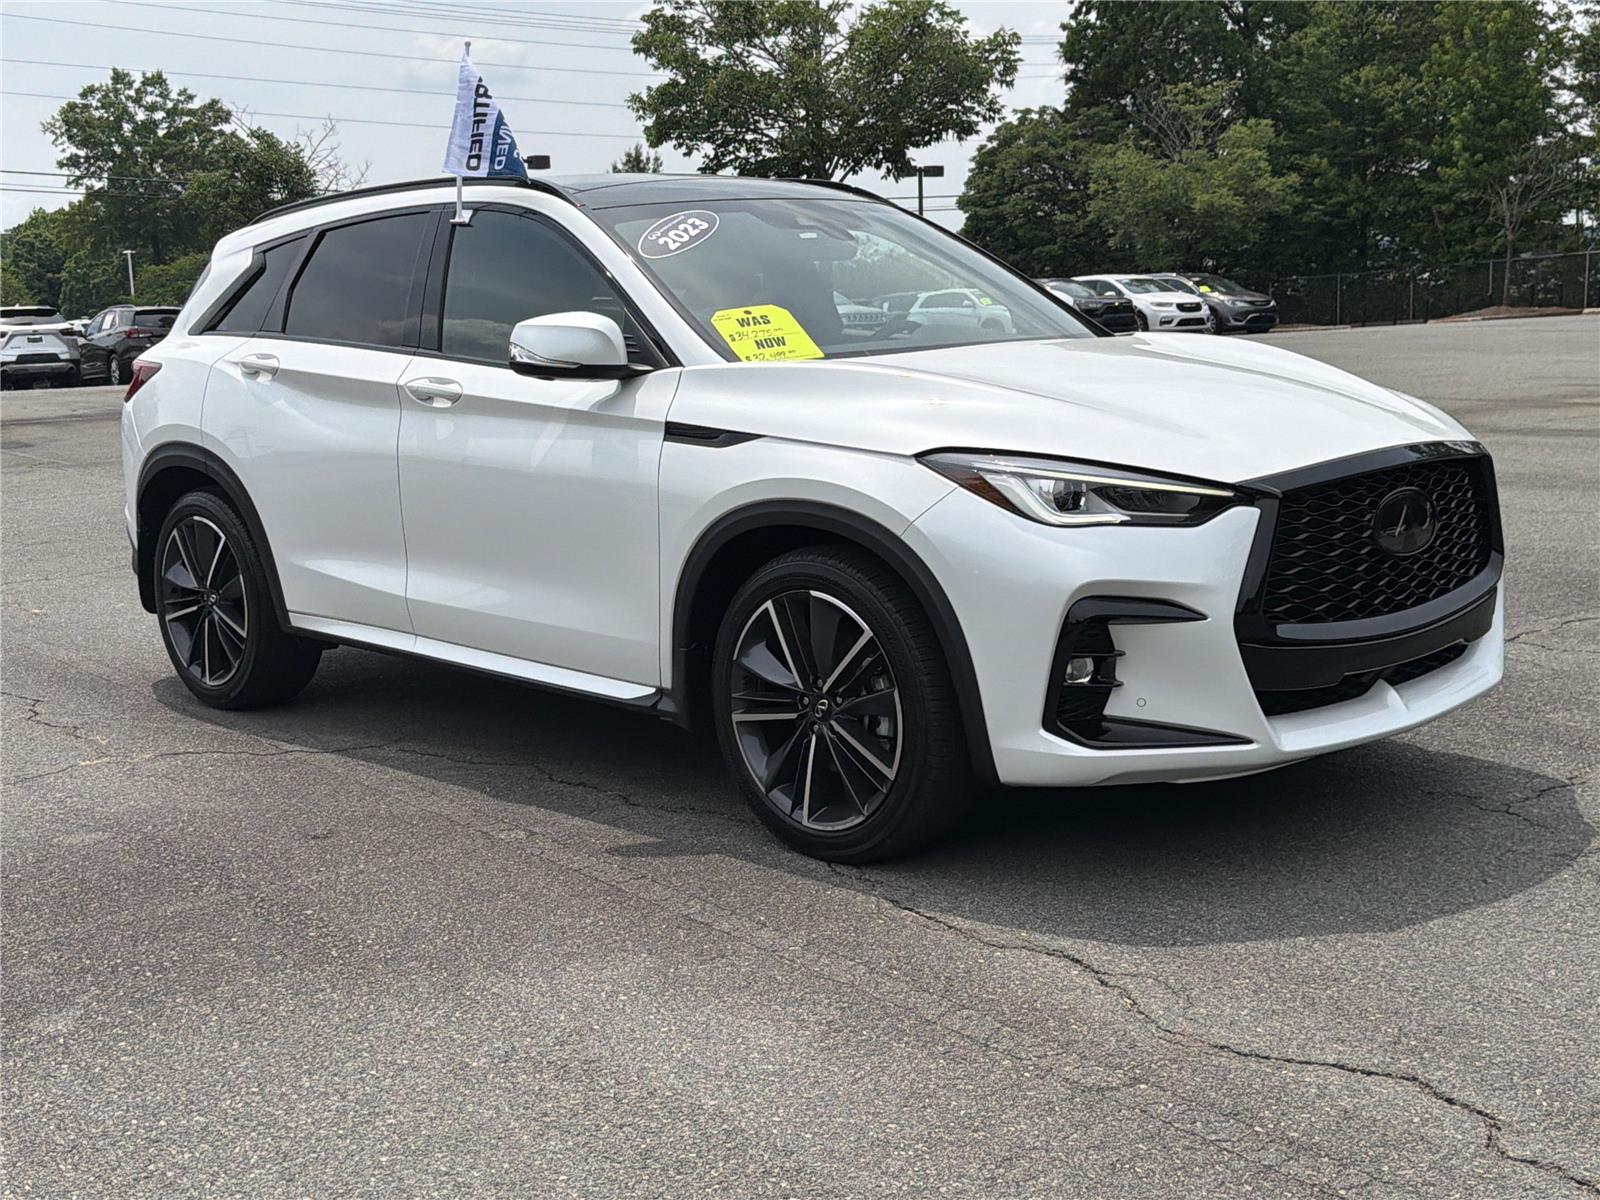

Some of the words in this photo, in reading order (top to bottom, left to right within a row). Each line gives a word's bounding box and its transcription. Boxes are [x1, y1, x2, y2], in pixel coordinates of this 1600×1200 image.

[658, 217, 709, 250] 2023
[736, 314, 771, 328] WAS
[754, 336, 787, 350] NOW
